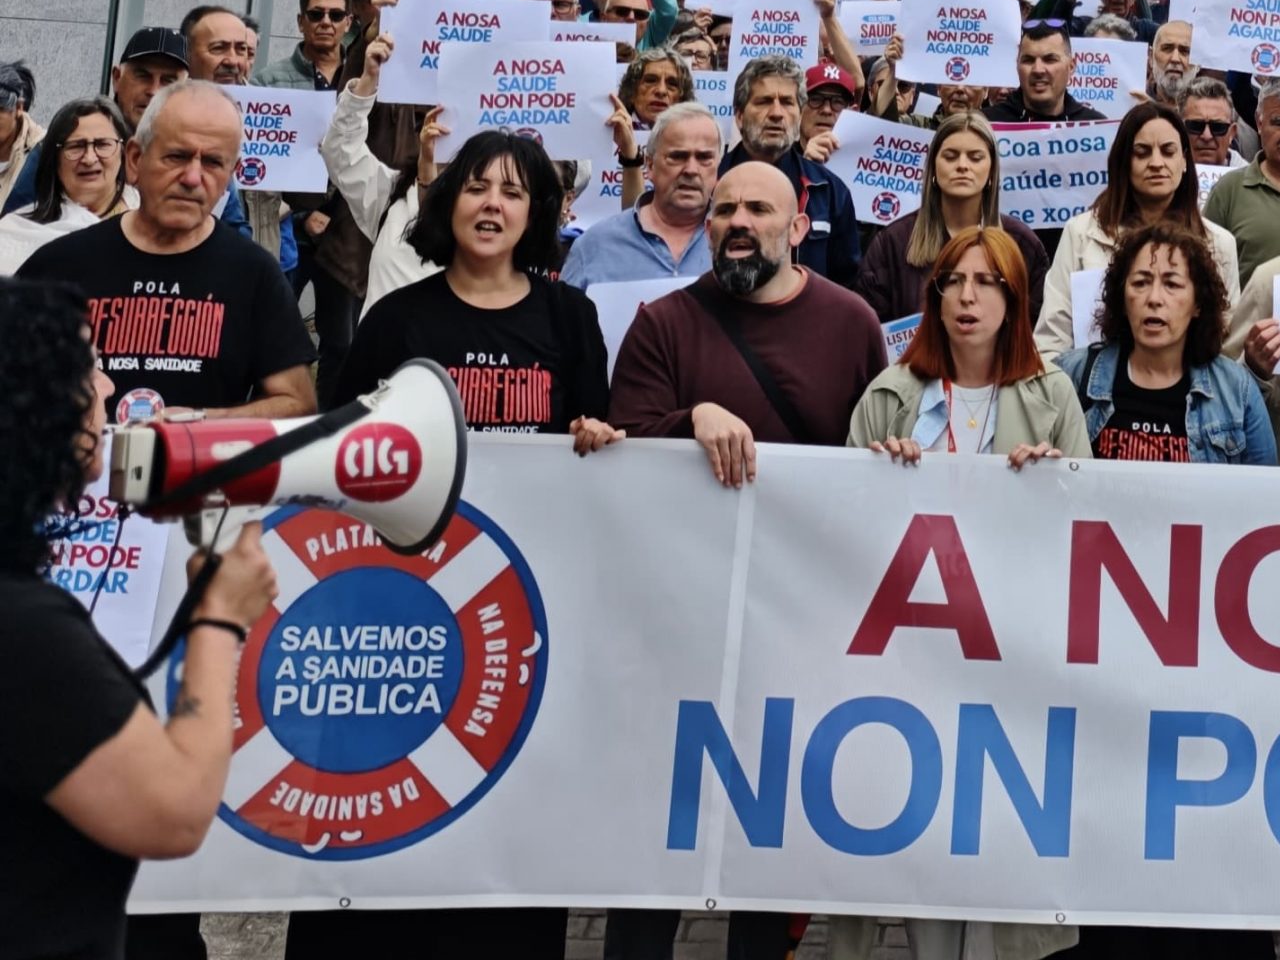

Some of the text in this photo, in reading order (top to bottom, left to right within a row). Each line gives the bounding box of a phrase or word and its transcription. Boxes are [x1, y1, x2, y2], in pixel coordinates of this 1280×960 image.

[436, 12, 500, 28] A NOSA
[752, 10, 800, 22] A NOSA
[938, 8, 986, 20] A NOSA
[1230, 8, 1267, 25] NON
[741, 34, 807, 47] NON PODE
[927, 30, 994, 44] NON PODE
[740, 46, 803, 58] AGARDAR
[926, 43, 989, 56] AGARDAR
[1074, 52, 1110, 64] NOSA
[493, 60, 565, 75] A NOSA
[1086, 78, 1118, 88] PODE
[480, 93, 576, 108] NON PODE
[246, 102, 291, 116] NOSA
[479, 110, 570, 124] AGARDAR
[257, 130, 297, 143] PODE
[873, 135, 884, 147] A
[1048, 136, 1106, 155] nosa
[857, 158, 892, 173] NON
[1000, 170, 1062, 191] aúde
[134, 282, 180, 294] POLA
[109, 358, 202, 372] NOSA SANIDADE
[466, 353, 509, 365] POLA
[345, 437, 409, 478] CIG
[70, 545, 141, 569] PODE
[846, 513, 1002, 662] A
[280, 625, 447, 651] SALVEMOS
[276, 656, 443, 680] A SANIDADE
[464, 602, 509, 738] NA DEFENSA
[273, 674, 442, 716] PÚBLICA
[666, 695, 1077, 858] NON
[269, 778, 419, 821] DA SANIDADE
